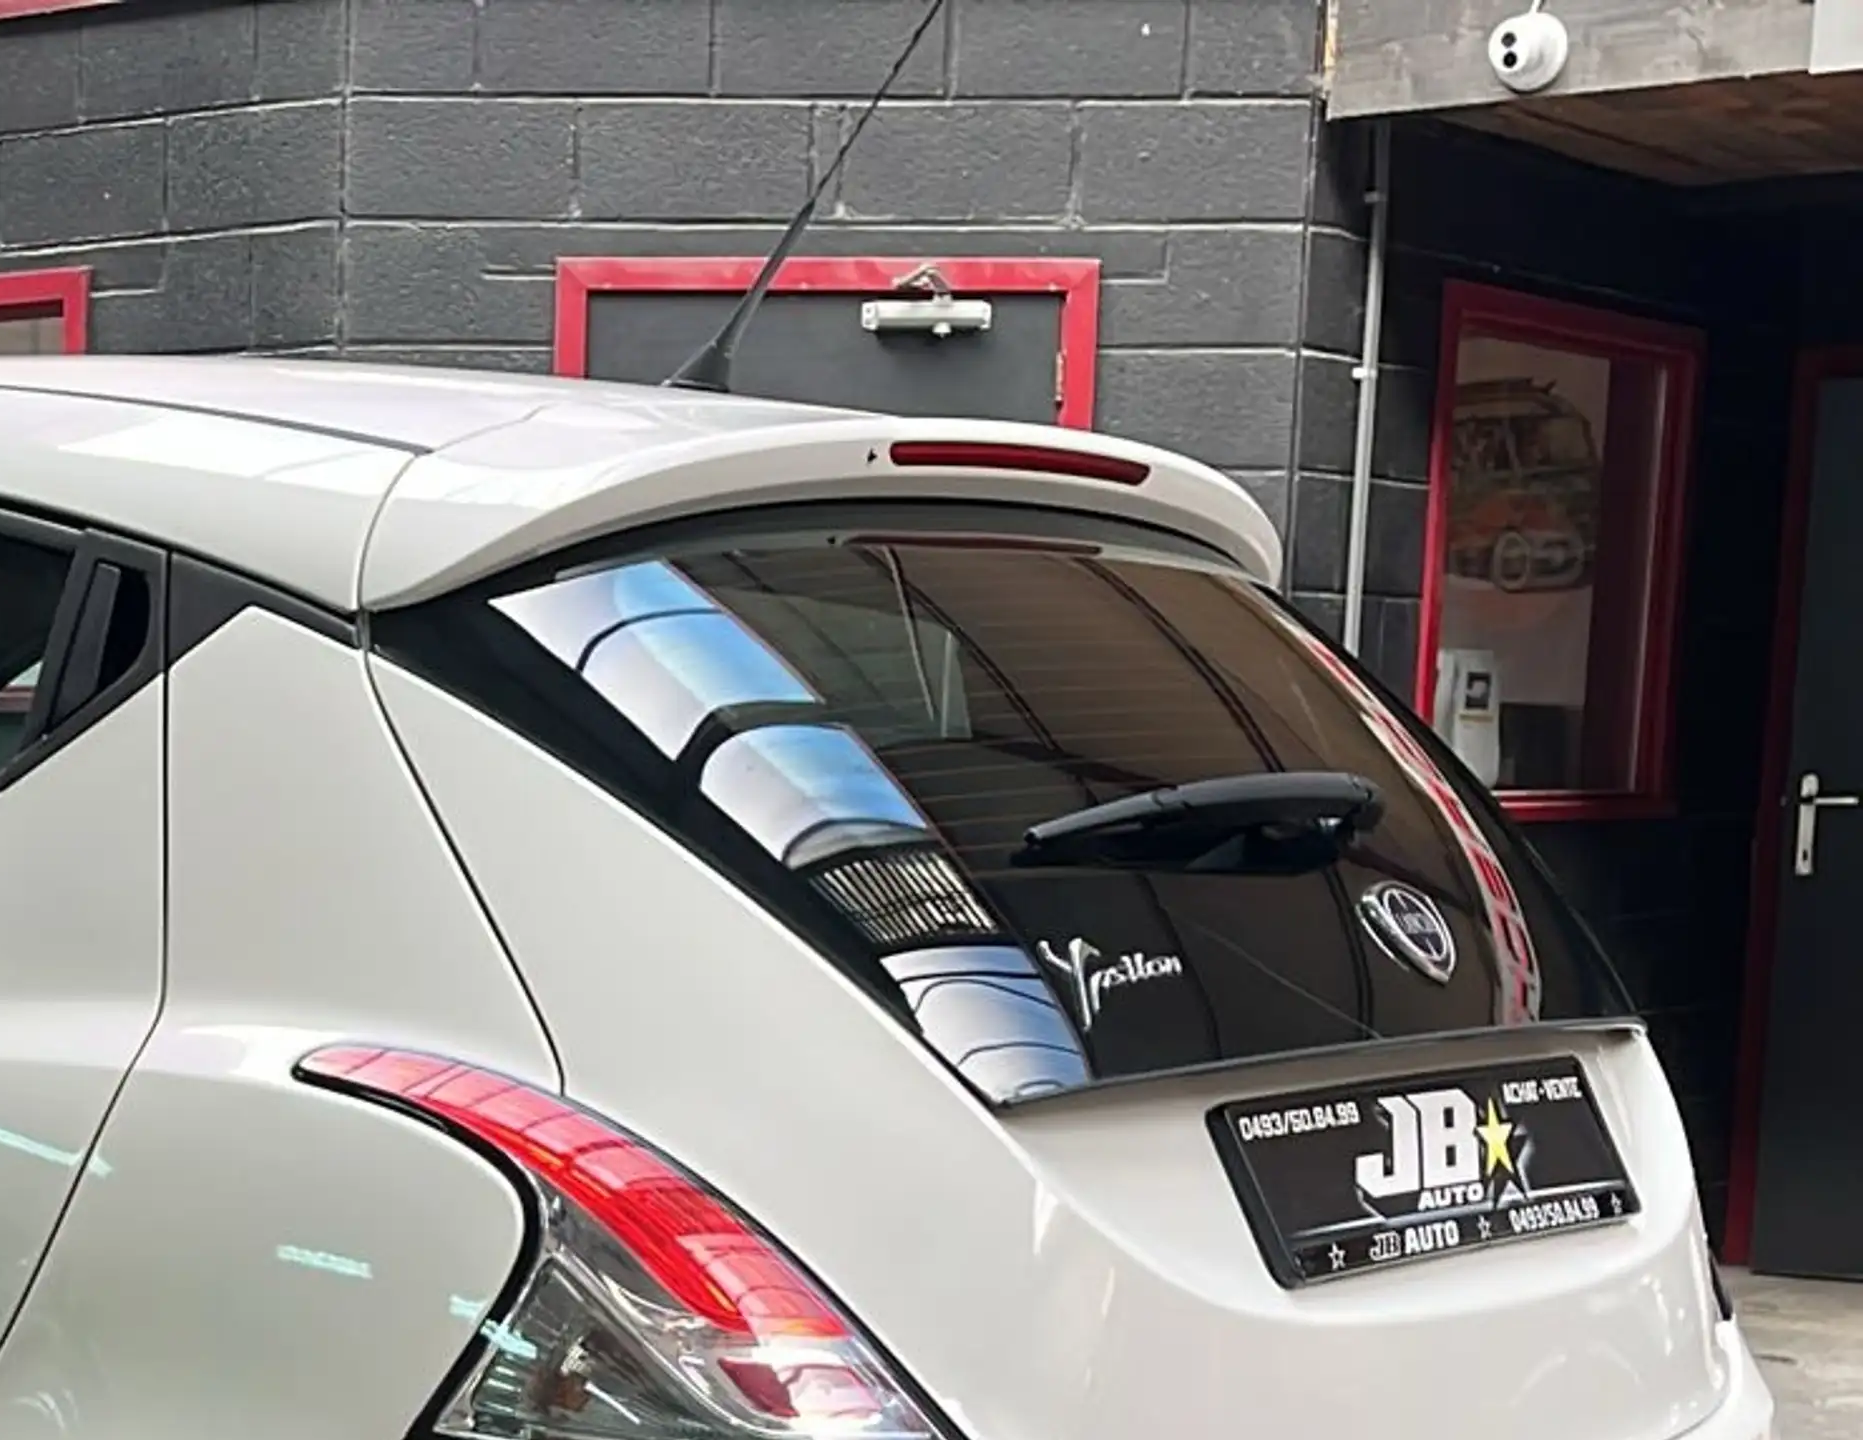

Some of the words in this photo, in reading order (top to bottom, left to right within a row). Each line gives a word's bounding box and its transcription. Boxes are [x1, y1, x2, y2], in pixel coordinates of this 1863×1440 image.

[1037, 937, 1183, 1032] Ypsilon
[1355, 1088, 1480, 1198] JB
[1418, 1182, 1485, 1211] AUTO
[1404, 1219, 1460, 1254] AUTO
